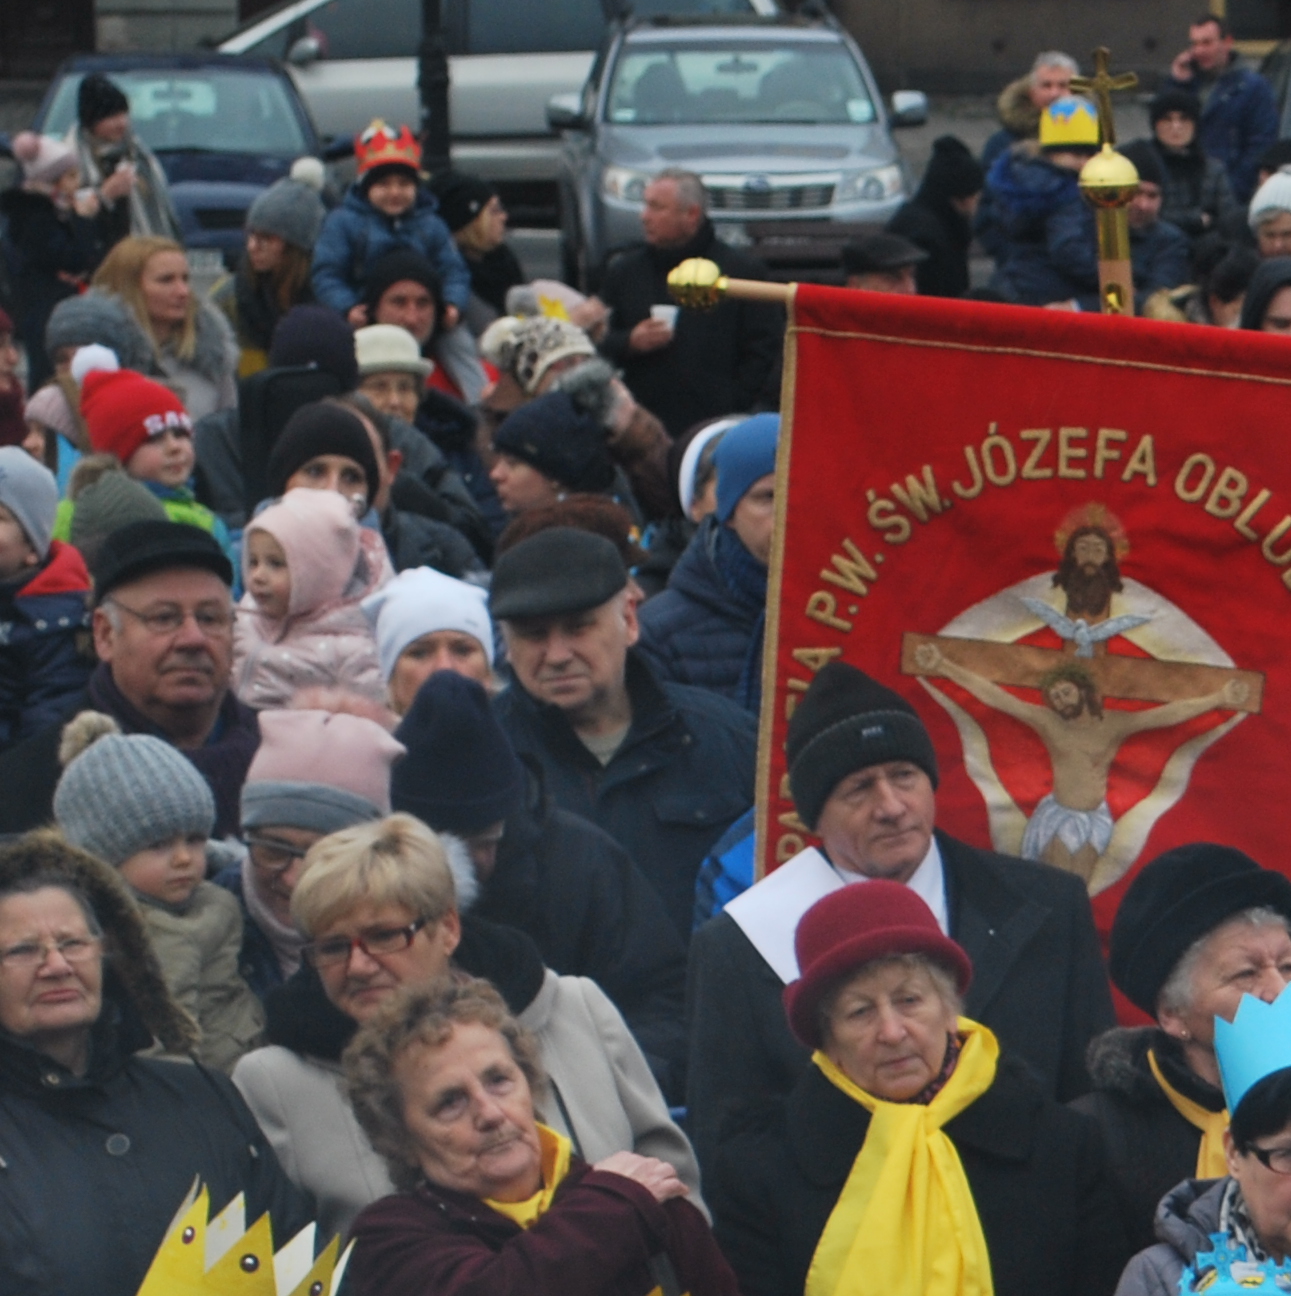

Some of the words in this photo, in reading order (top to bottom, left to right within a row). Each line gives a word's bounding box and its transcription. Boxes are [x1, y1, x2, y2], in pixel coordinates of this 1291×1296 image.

[805, 537, 885, 632] P.W.
[866, 464, 953, 544] ŚW.
[951, 421, 1158, 499] JÓZEFA
